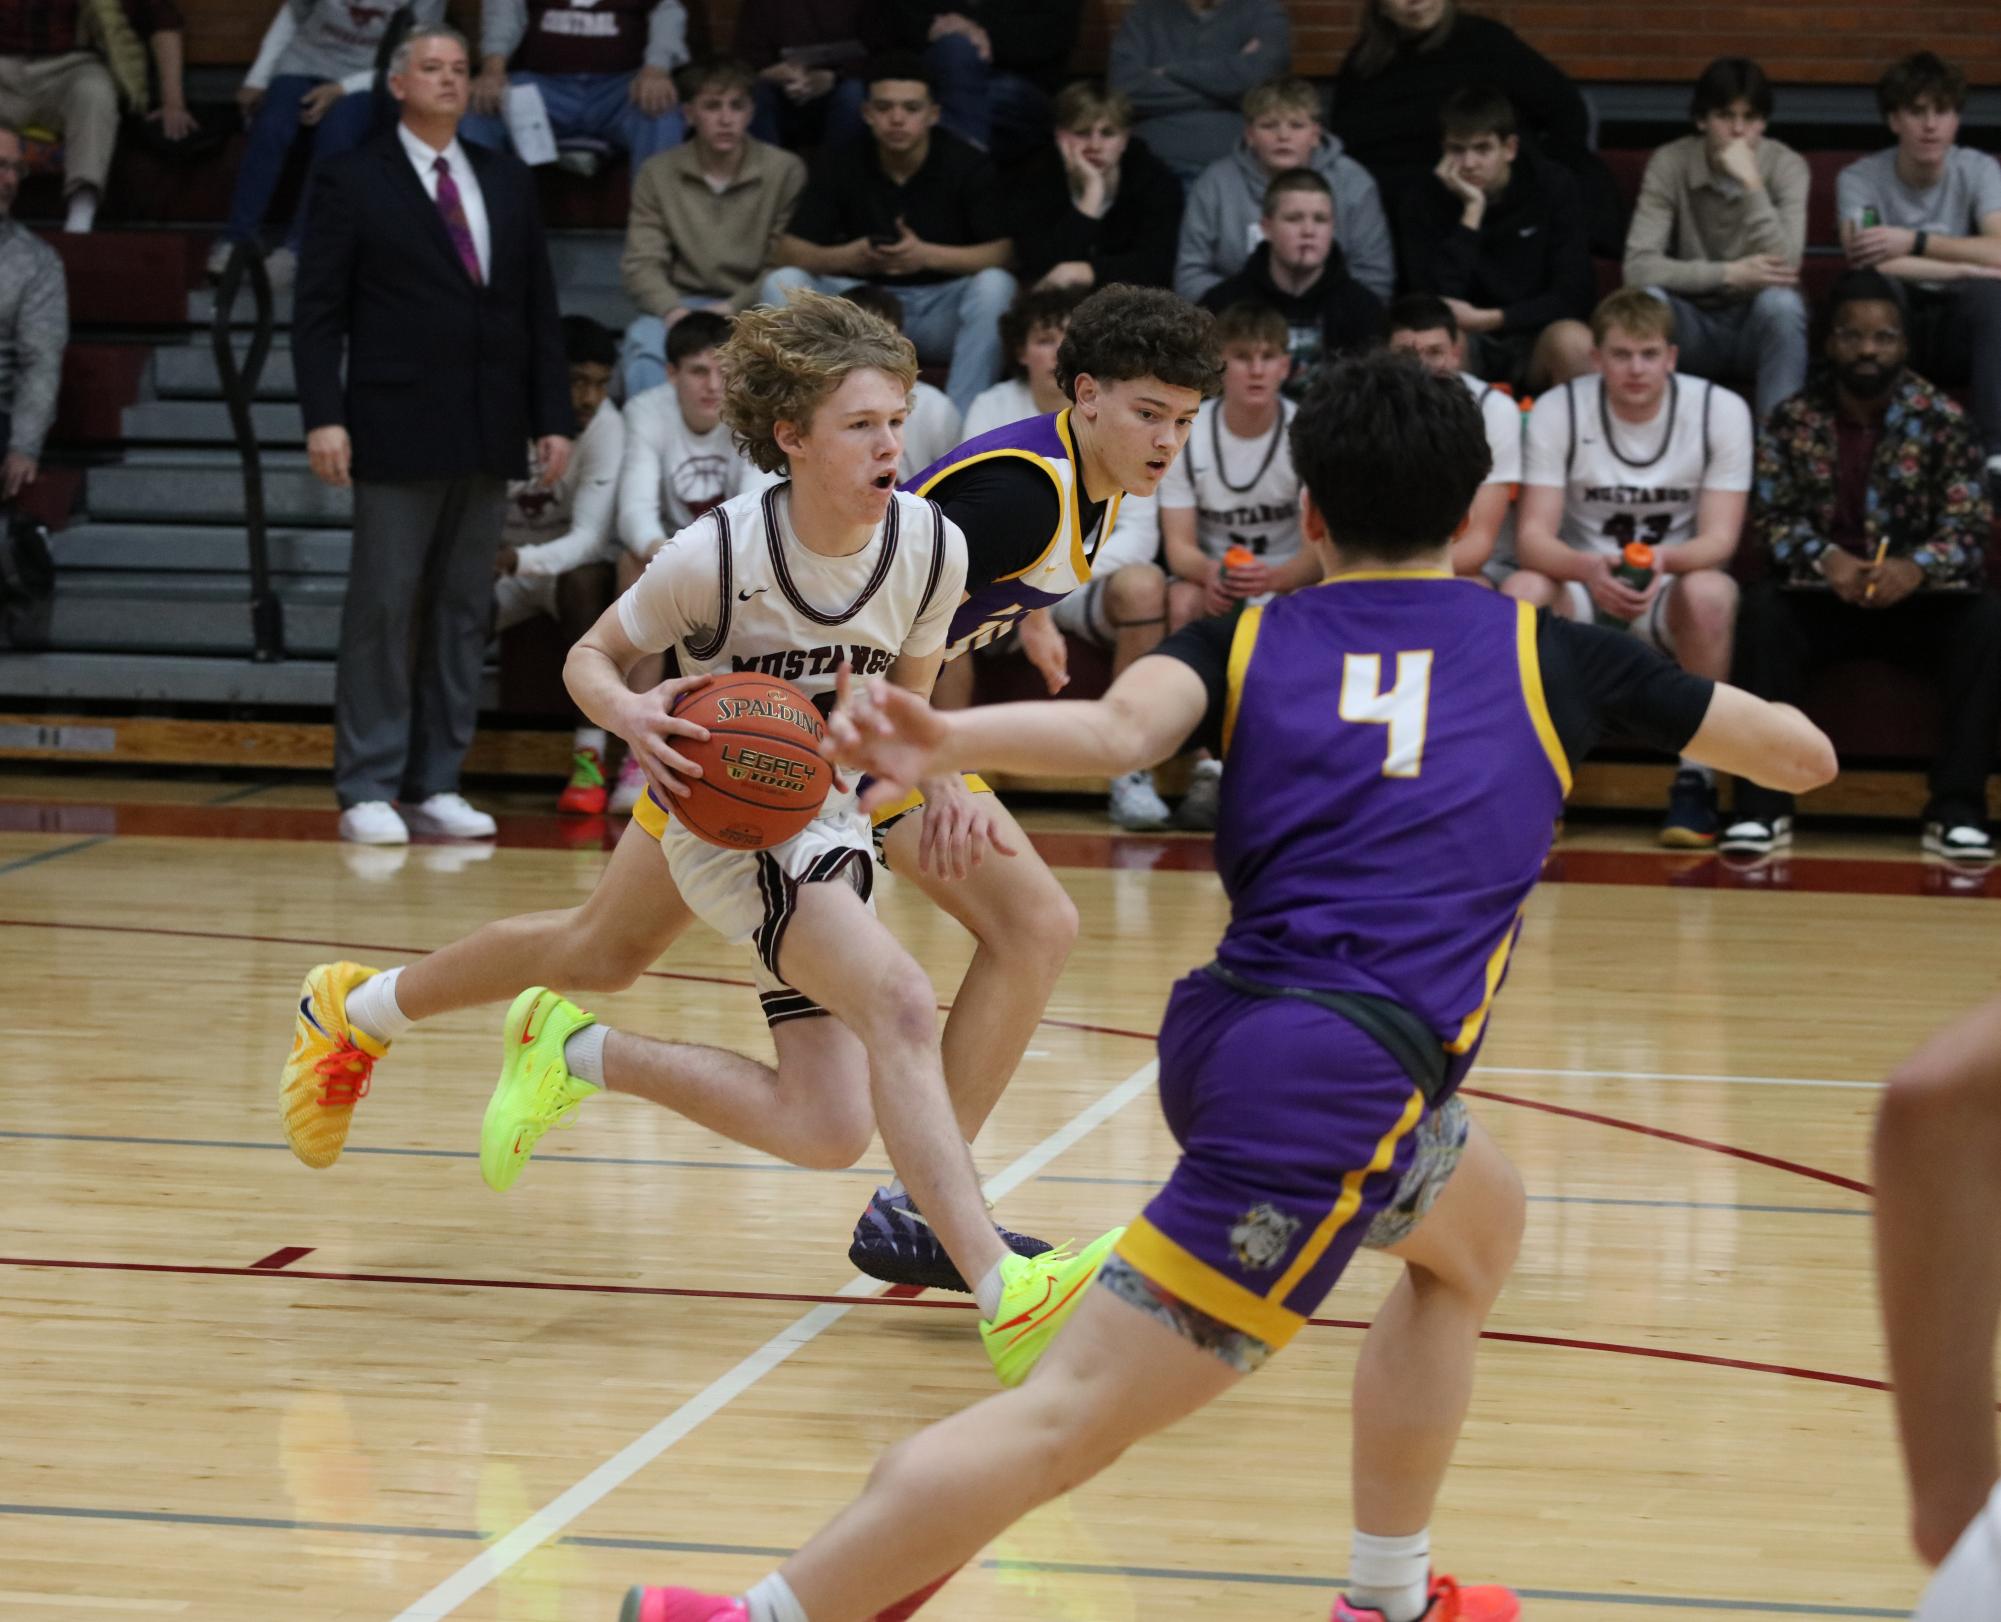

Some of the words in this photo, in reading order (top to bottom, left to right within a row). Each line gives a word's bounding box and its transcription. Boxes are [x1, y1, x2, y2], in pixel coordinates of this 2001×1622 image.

[717, 697, 825, 743] SPALDING
[1338, 649, 1434, 778] 4
[720, 744, 817, 781] LEGACY
[750, 771, 806, 793] 1000
